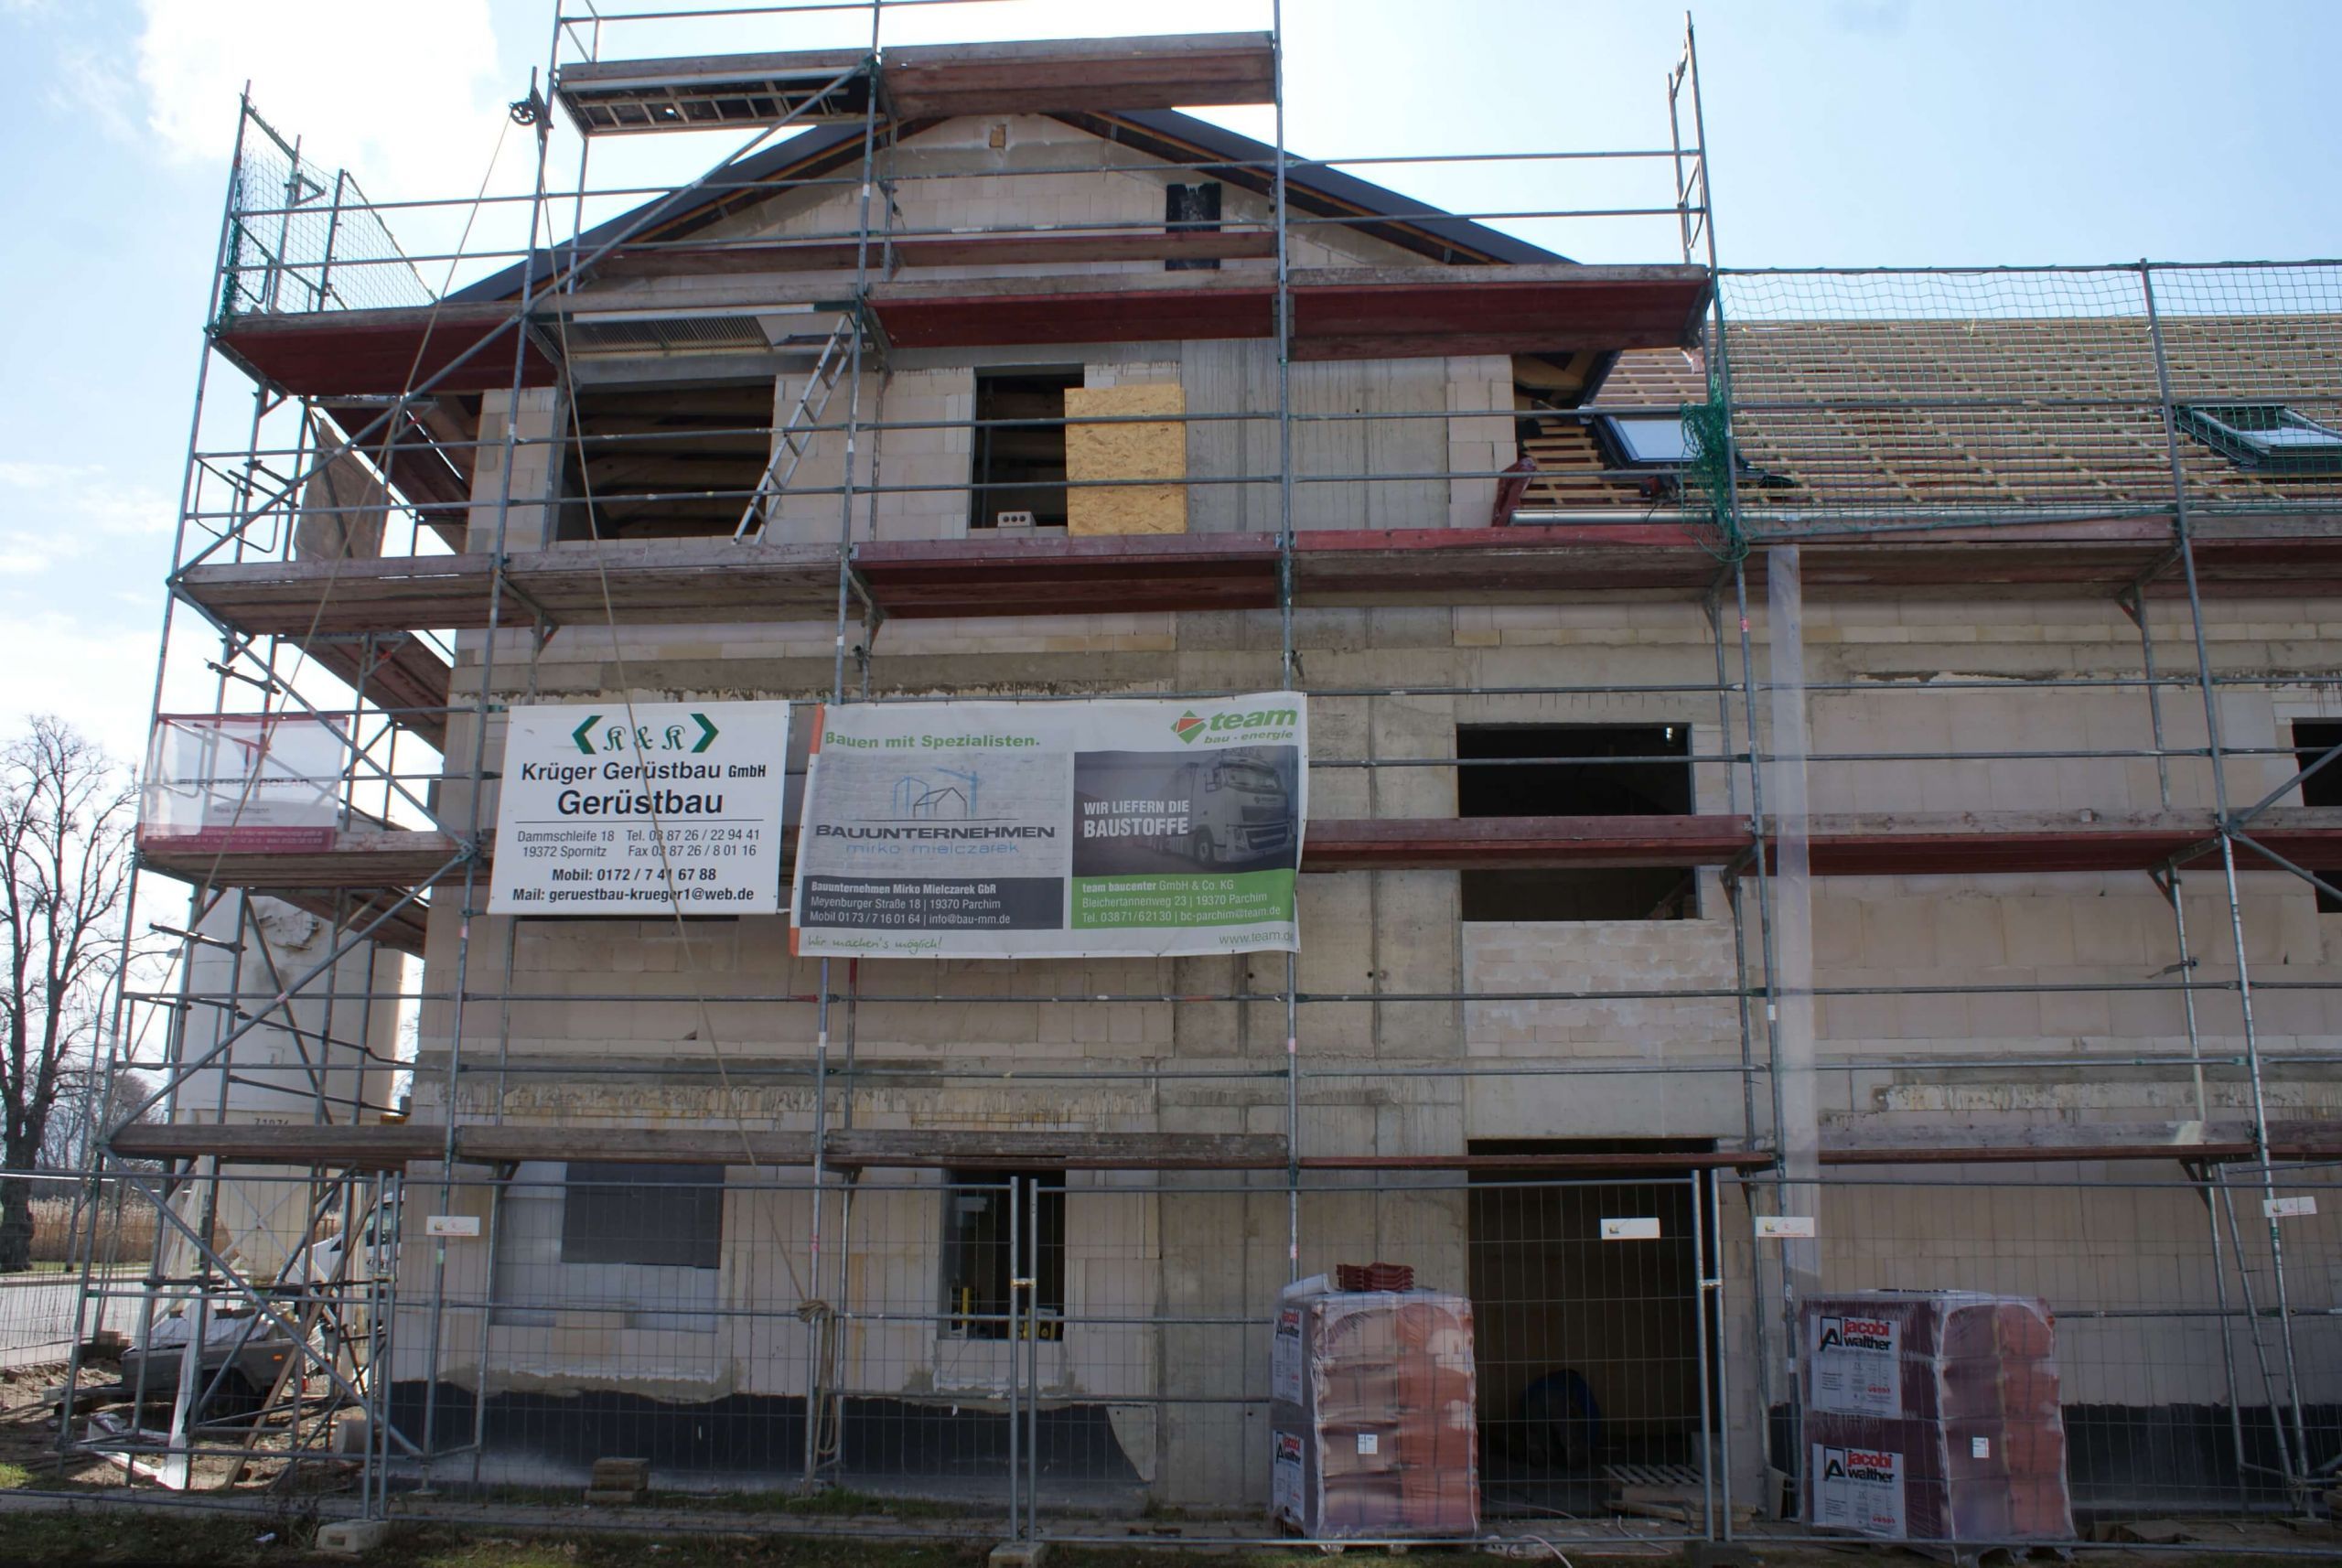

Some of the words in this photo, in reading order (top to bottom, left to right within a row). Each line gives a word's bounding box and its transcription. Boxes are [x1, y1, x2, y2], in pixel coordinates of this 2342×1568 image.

[1209, 709, 1297, 731] team
[825, 732, 878, 748] Bauen
[886, 732, 915, 747] mit
[921, 734, 1040, 749] Spezialisten.
[1204, 734, 1230, 745] bau
[1241, 730, 1294, 742] energie
[521, 762, 596, 785] Krüger
[603, 761, 721, 779] Gerüstbau
[728, 765, 767, 778] GmbH
[557, 789, 723, 814] Gerüstbau
[1084, 801, 1109, 815] WIR
[1112, 800, 1165, 814] LIEFERN
[1168, 800, 1189, 812] DIE
[815, 824, 1055, 840] BAUUNTERNEHMEN
[1084, 817, 1188, 838] BAUSTOFFE
[517, 831, 597, 843] Dammschleife
[600, 831, 615, 842] 18
[627, 830, 645, 842] Tel.
[667, 830, 682, 841] 87
[684, 830, 699, 841] 26
[710, 830, 725, 841] 22
[727, 829, 743, 841] 94
[746, 829, 760, 840] 41
[523, 846, 557, 857] 19372
[560, 845, 607, 859] Spornitz
[628, 845, 648, 857] Fax
[669, 845, 684, 856] 87
[687, 844, 702, 856] 26
[713, 845, 720, 856] 8
[723, 844, 736, 856] 01
[742, 844, 757, 855] 16
[845, 843, 900, 854] mirko
[912, 842, 1019, 854] mielczarek
[552, 868, 593, 881] Mobil:
[596, 868, 630, 881] 0172
[645, 869, 653, 880] 7
[678, 868, 694, 880] 67
[699, 868, 716, 880] 88
[811, 881, 890, 894] Bauunternehmen
[893, 884, 920, 895] Mirko
[923, 884, 975, 895] Mielczarek
[977, 884, 996, 894] GbR
[1082, 883, 1106, 894] team
[1108, 881, 1156, 894] baucenter
[1159, 881, 1188, 891] GmbH
[1191, 881, 1199, 891] &
[1219, 879, 1234, 890] KG
[512, 888, 545, 900] Mail:
[549, 887, 754, 903] geruestbau-krueger1@web.de
[1082, 896, 1171, 908] Bleichertannenweg
[1174, 896, 1187, 906] 23
[1196, 895, 1226, 905] 19370
[1229, 893, 1267, 904] Parchim
[811, 897, 873, 909] Meyenburger
[875, 898, 906, 909] Straße
[909, 899, 920, 908] 18
[929, 899, 960, 909] 19370
[962, 899, 1001, 909] Parchim
[810, 911, 835, 921] Mobil
[929, 914, 1011, 925] info@bau-mm.de
[1082, 913, 1098, 923] Tel.
[1843, 1318, 1891, 1337] jacobi
[1844, 1335, 1891, 1350] walther
[1846, 1449, 1894, 1468] jacobi
[1848, 1466, 1894, 1483] walther
